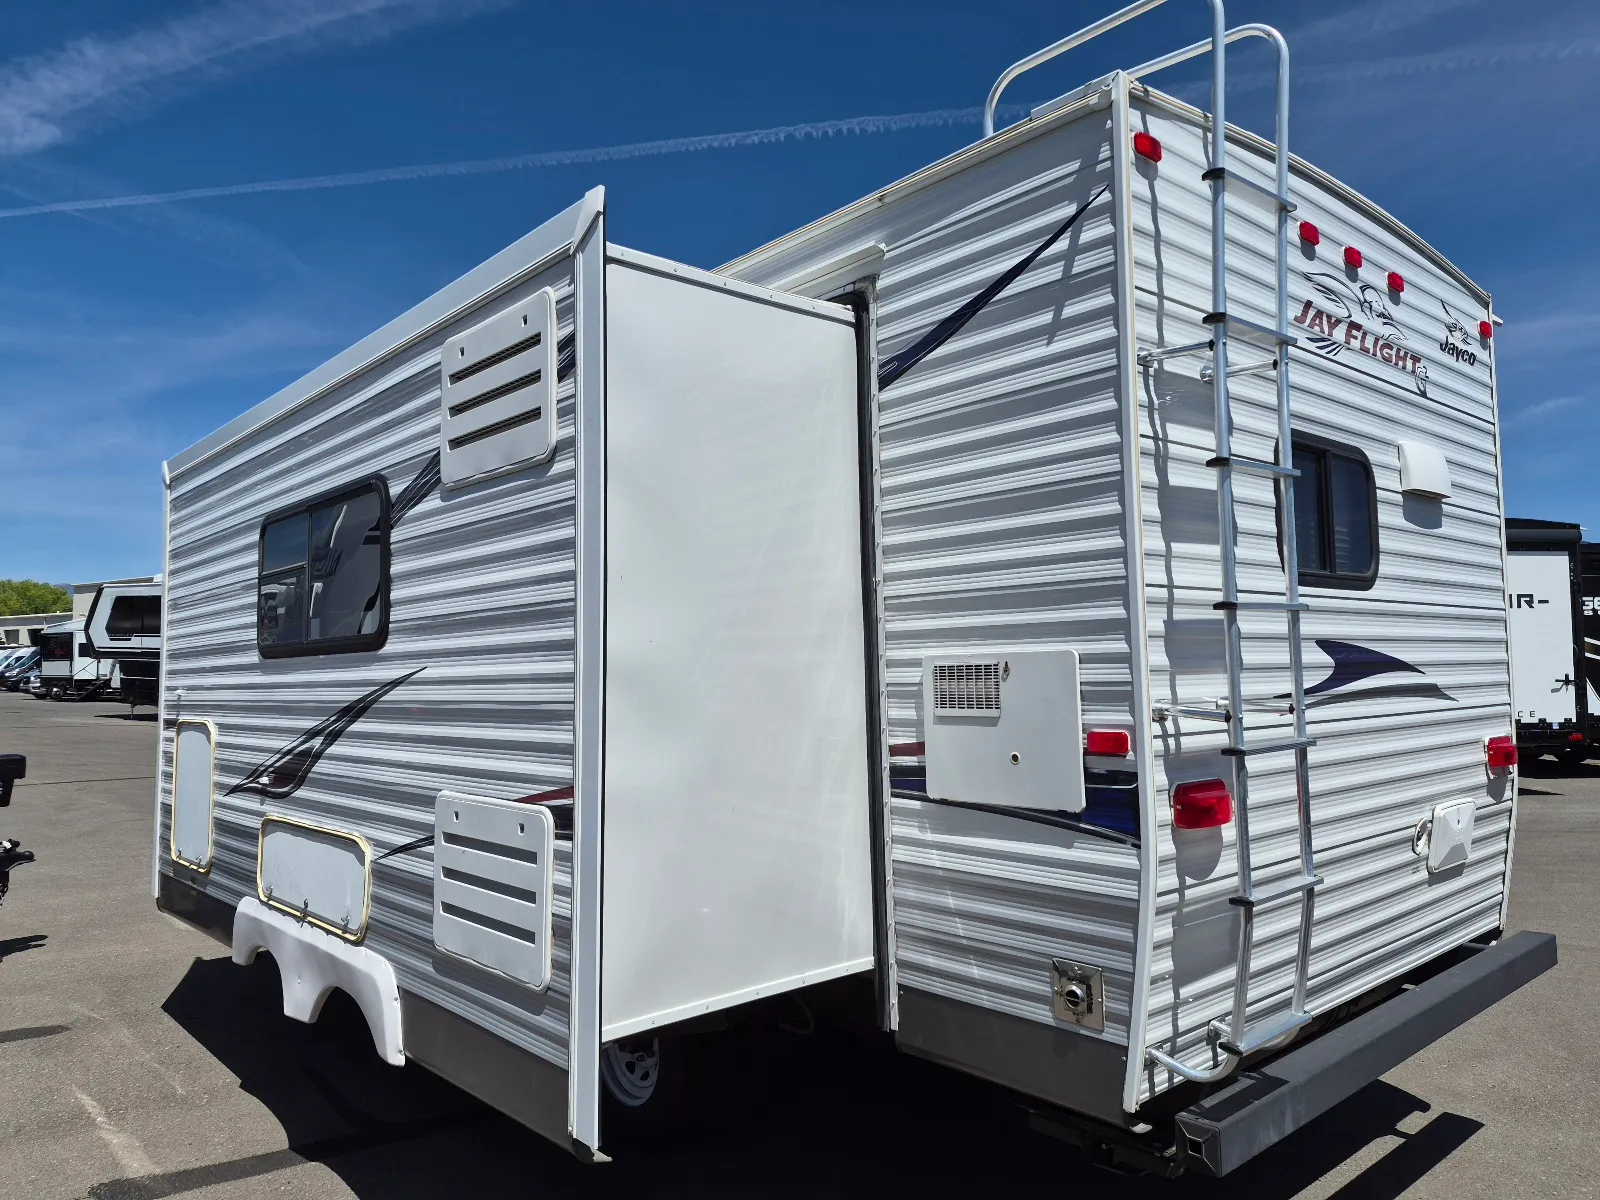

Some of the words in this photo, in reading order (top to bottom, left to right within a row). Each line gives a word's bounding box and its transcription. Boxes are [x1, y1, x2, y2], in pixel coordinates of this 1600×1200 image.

[1294, 300, 1343, 338] JAY
[1344, 320, 1422, 375] FLIGHT
[1439, 335, 1477, 367] Jayco
